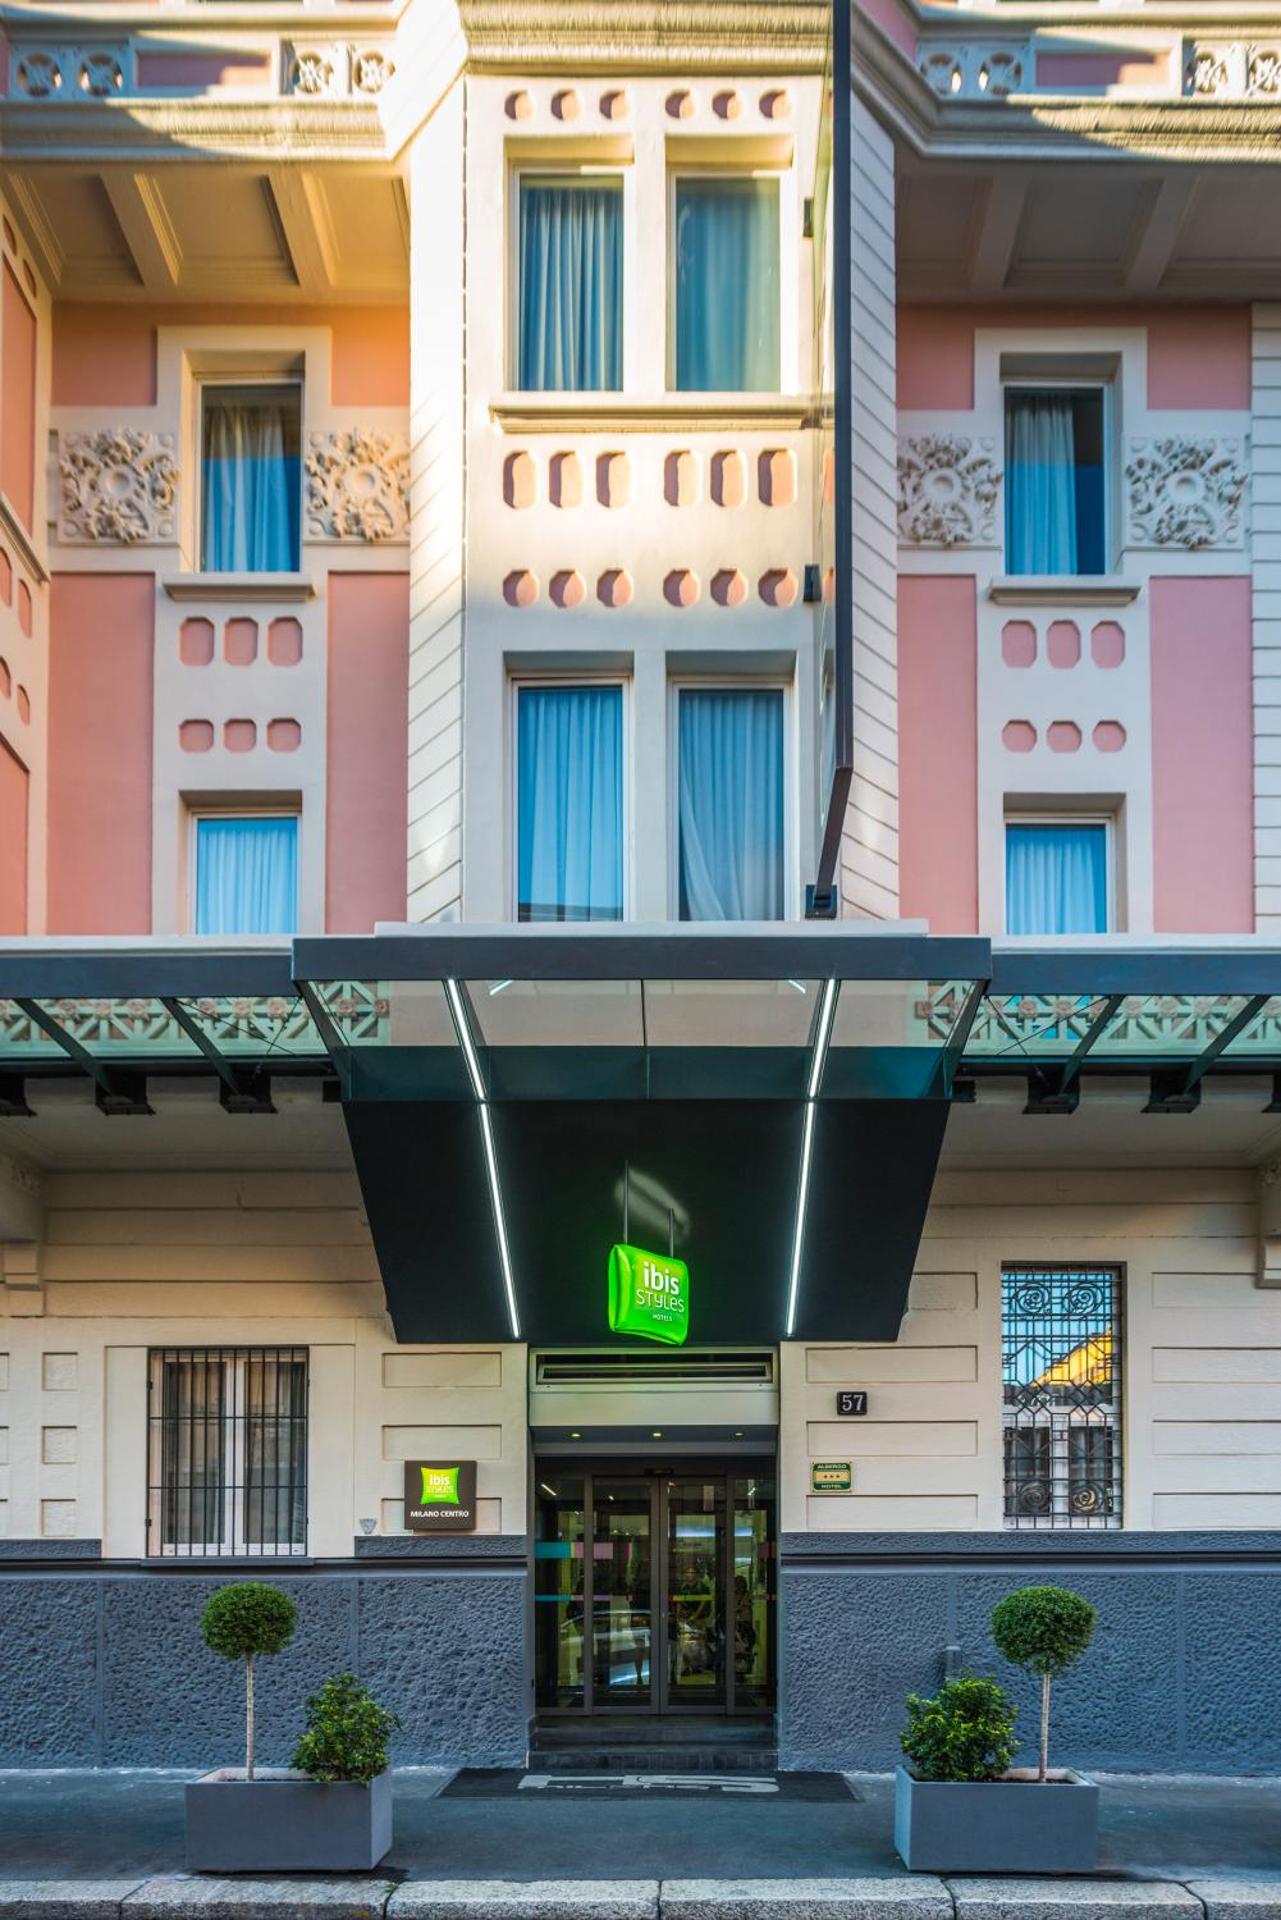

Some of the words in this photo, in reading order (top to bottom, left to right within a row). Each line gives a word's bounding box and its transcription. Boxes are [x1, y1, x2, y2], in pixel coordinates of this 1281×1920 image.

[643, 1260, 680, 1295] ibis
[842, 1394, 865, 1411] 57
[429, 1473, 451, 1486] ibis
[410, 1510, 440, 1518] MILANO
[440, 1510, 469, 1518] CENTRO
